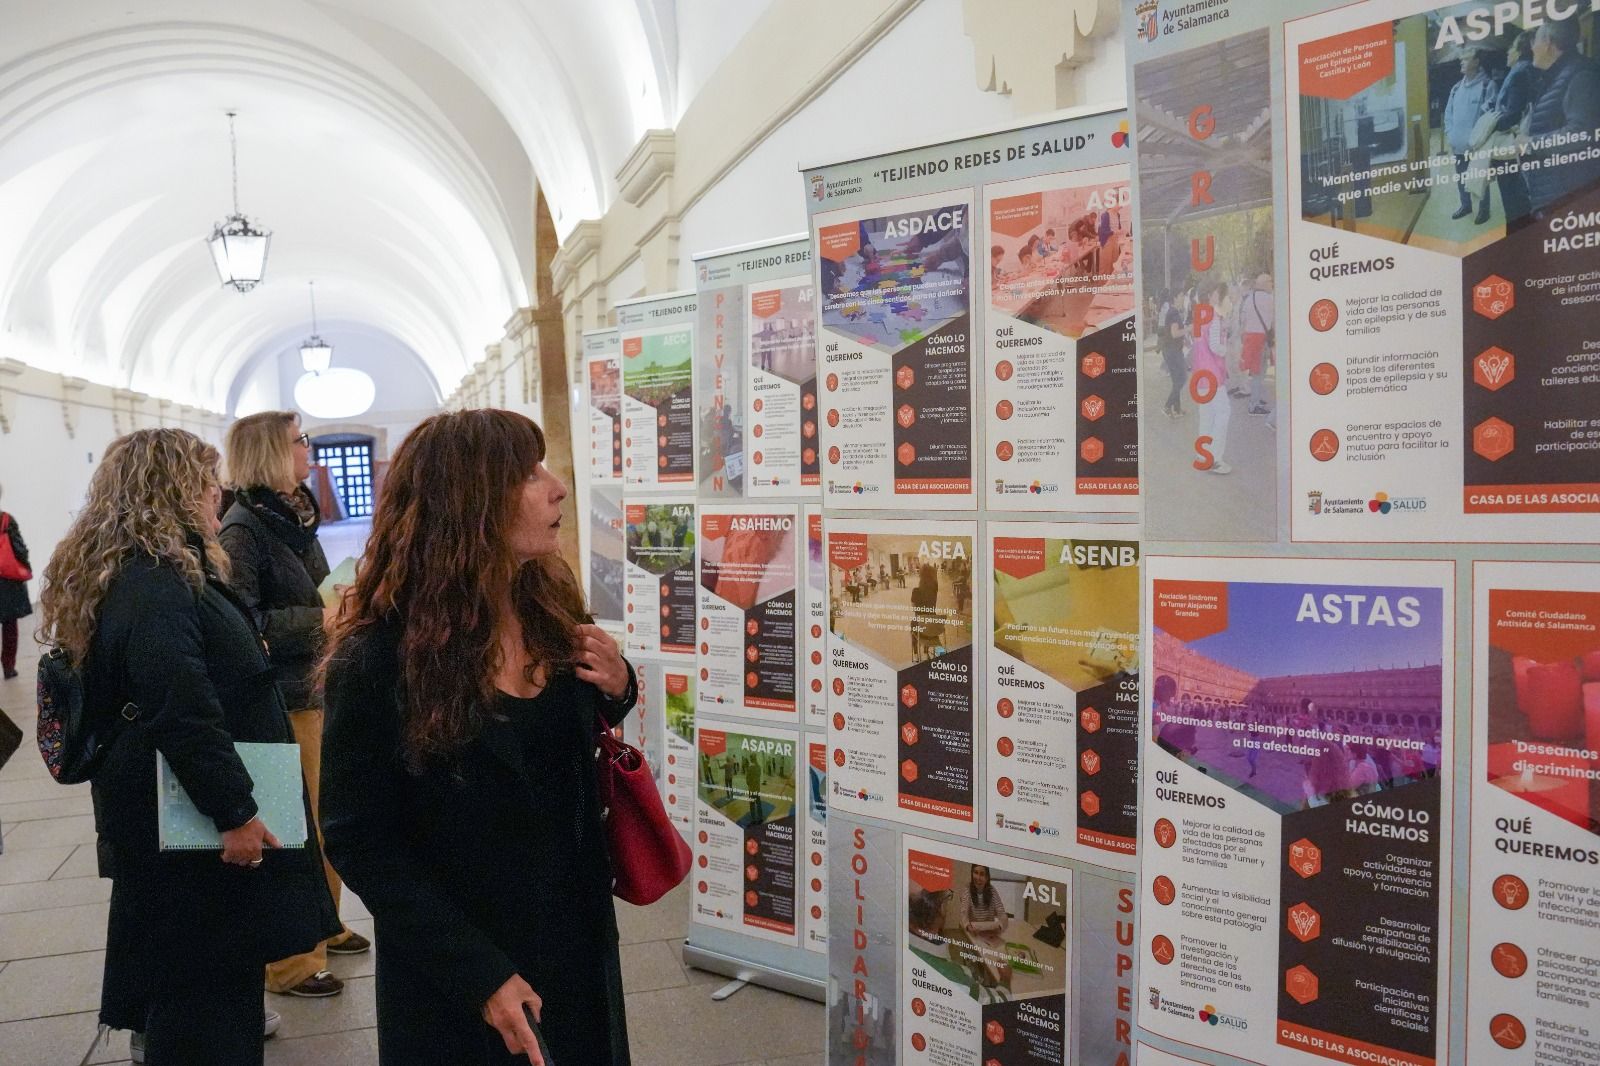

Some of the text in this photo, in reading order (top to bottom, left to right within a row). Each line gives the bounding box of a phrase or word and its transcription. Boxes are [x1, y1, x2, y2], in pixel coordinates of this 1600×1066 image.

[1177, 9, 1230, 31] Salamanca
[1434, 0, 1600, 49] ASPEC
[1354, 39, 1387, 52] Personas
[954, 149, 1001, 170] REDES
[1007, 145, 1025, 161] DE
[1410, 154, 1460, 171] unidos,
[1464, 146, 1515, 161] fuertes
[1519, 143, 1528, 156] y
[1531, 130, 1592, 150] visibles,
[1338, 189, 1361, 204] que
[1364, 181, 1401, 197] nadie
[1404, 177, 1433, 190] viva
[1436, 174, 1449, 185] la
[1452, 162, 1518, 185] epilepsia
[1521, 160, 1540, 171] en
[884, 209, 962, 239] ASDACE
[1309, 242, 1339, 262] QUÉ
[1309, 257, 1395, 281] QUEREMOS
[1188, 104, 1218, 471] GRUPOS
[1525, 274, 1575, 288] Organizar
[1346, 289, 1427, 307] Mejorar calidad
[1396, 301, 1440, 314] personas
[1364, 312, 1405, 325] epilepsia
[996, 326, 1013, 337] QUÉ
[1346, 326, 1380, 336] familias
[826, 342, 838, 352] QUÉ
[928, 334, 965, 345] CÓMO LO
[996, 337, 1043, 349] QUEREMOS
[826, 352, 863, 363] QUEREMOS
[925, 345, 965, 356] HACEMOS
[1346, 350, 1439, 365] Difundir información
[1387, 363, 1435, 372] diferentes
[1383, 372, 1426, 384] epilepsia
[1541, 376, 1580, 386] talleres
[1346, 384, 1407, 397] problemática
[1346, 421, 1426, 432] Generar espacios
[1544, 419, 1587, 429] Habilitar
[1346, 433, 1392, 442] encuentro
[1402, 440, 1437, 449] facilitar
[1346, 453, 1385, 461] inclusión
[1393, 500, 1427, 510] SALUD
[1469, 494, 1504, 505] CASA
[1506, 494, 1522, 504] DE
[1524, 494, 1548, 504] LAS
[671, 506, 691, 517] AFA
[730, 517, 792, 531] ASAHEMO
[918, 540, 967, 560] ASEA
[1060, 544, 1139, 567] ASENB
[767, 600, 783, 609] CÓMO
[1295, 593, 1421, 627] ASTAS
[765, 608, 792, 617] HACEMOS
[1539, 611, 1586, 620] Ciudadano
[1546, 621, 1596, 631] Salamanca
[833, 648, 844, 657] QUÉ
[833, 659, 869, 670] QUEREMOS
[931, 661, 968, 672] CÓMO LO
[998, 665, 1015, 675] QUÉ
[928, 671, 968, 683] HACEMOS
[998, 677, 1045, 690] QUEREMOS
[1215, 720, 1245, 731] estar
[1247, 721, 1295, 738] siempre
[1297, 728, 1340, 742] activos
[1342, 734, 1373, 746] para
[1376, 738, 1425, 751] ayudar
[741, 738, 792, 757] ASAPAR
[1233, 738, 1321, 757] a las afectadas
[1156, 770, 1178, 785] QUÉ
[1155, 787, 1225, 808] QUEREMOS
[1351, 800, 1429, 824] CÓMO LO
[785, 825, 793, 833] LO
[1182, 819, 1253, 836] Mejorar calidad
[1345, 819, 1429, 843] HACEMOS
[1495, 817, 1532, 834] QUÉ
[1079, 833, 1116, 847] CASA LAS
[1182, 837, 1222, 850] afectadas
[1225, 835, 1263, 847] personas
[1495, 837, 1599, 864] QUEREMOS
[1363, 861, 1417, 876] actividades
[1386, 854, 1432, 868] Organizar
[1375, 873, 1432, 888] convivencia
[1538, 878, 1590, 894] Promover
[1022, 881, 1060, 906] ASL
[1181, 883, 1271, 906] Aumentar visibilidad
[1380, 882, 1429, 898] formación
[1181, 901, 1235, 917] conocimiento
[1538, 899, 1599, 918] infecciones
[1380, 917, 1430, 933] Desarrollar
[1538, 911, 1600, 928] transmisión
[1365, 925, 1416, 941] campañas
[1180, 934, 1217, 948] Promover
[1362, 934, 1430, 954] sensibilización,
[1180, 943, 1232, 960] investigación
[1332, 937, 1430, 963] difusión divulgación
[1537, 947, 1576, 961] Ofrecer
[912, 967, 927, 979] QUÉ
[1180, 961, 1217, 975] derechos
[1537, 959, 1597, 976] psicosocial
[1180, 970, 1216, 984] personas
[911, 977, 953, 997] QUEREMOS
[1355, 979, 1415, 999] Participación
[1536, 980, 1587, 997] personas
[1536, 988, 1590, 1008] familiares
[1020, 1002, 1060, 1021] CÓMO LO
[1016, 1012, 1060, 1032] HACEMOS
[1220, 1015, 1248, 1030] SALUD
[1391, 1018, 1429, 1033] sociales
[1536, 1017, 1576, 1033] Reducir
[1281, 1029, 1344, 1054] CASA DE LAS
